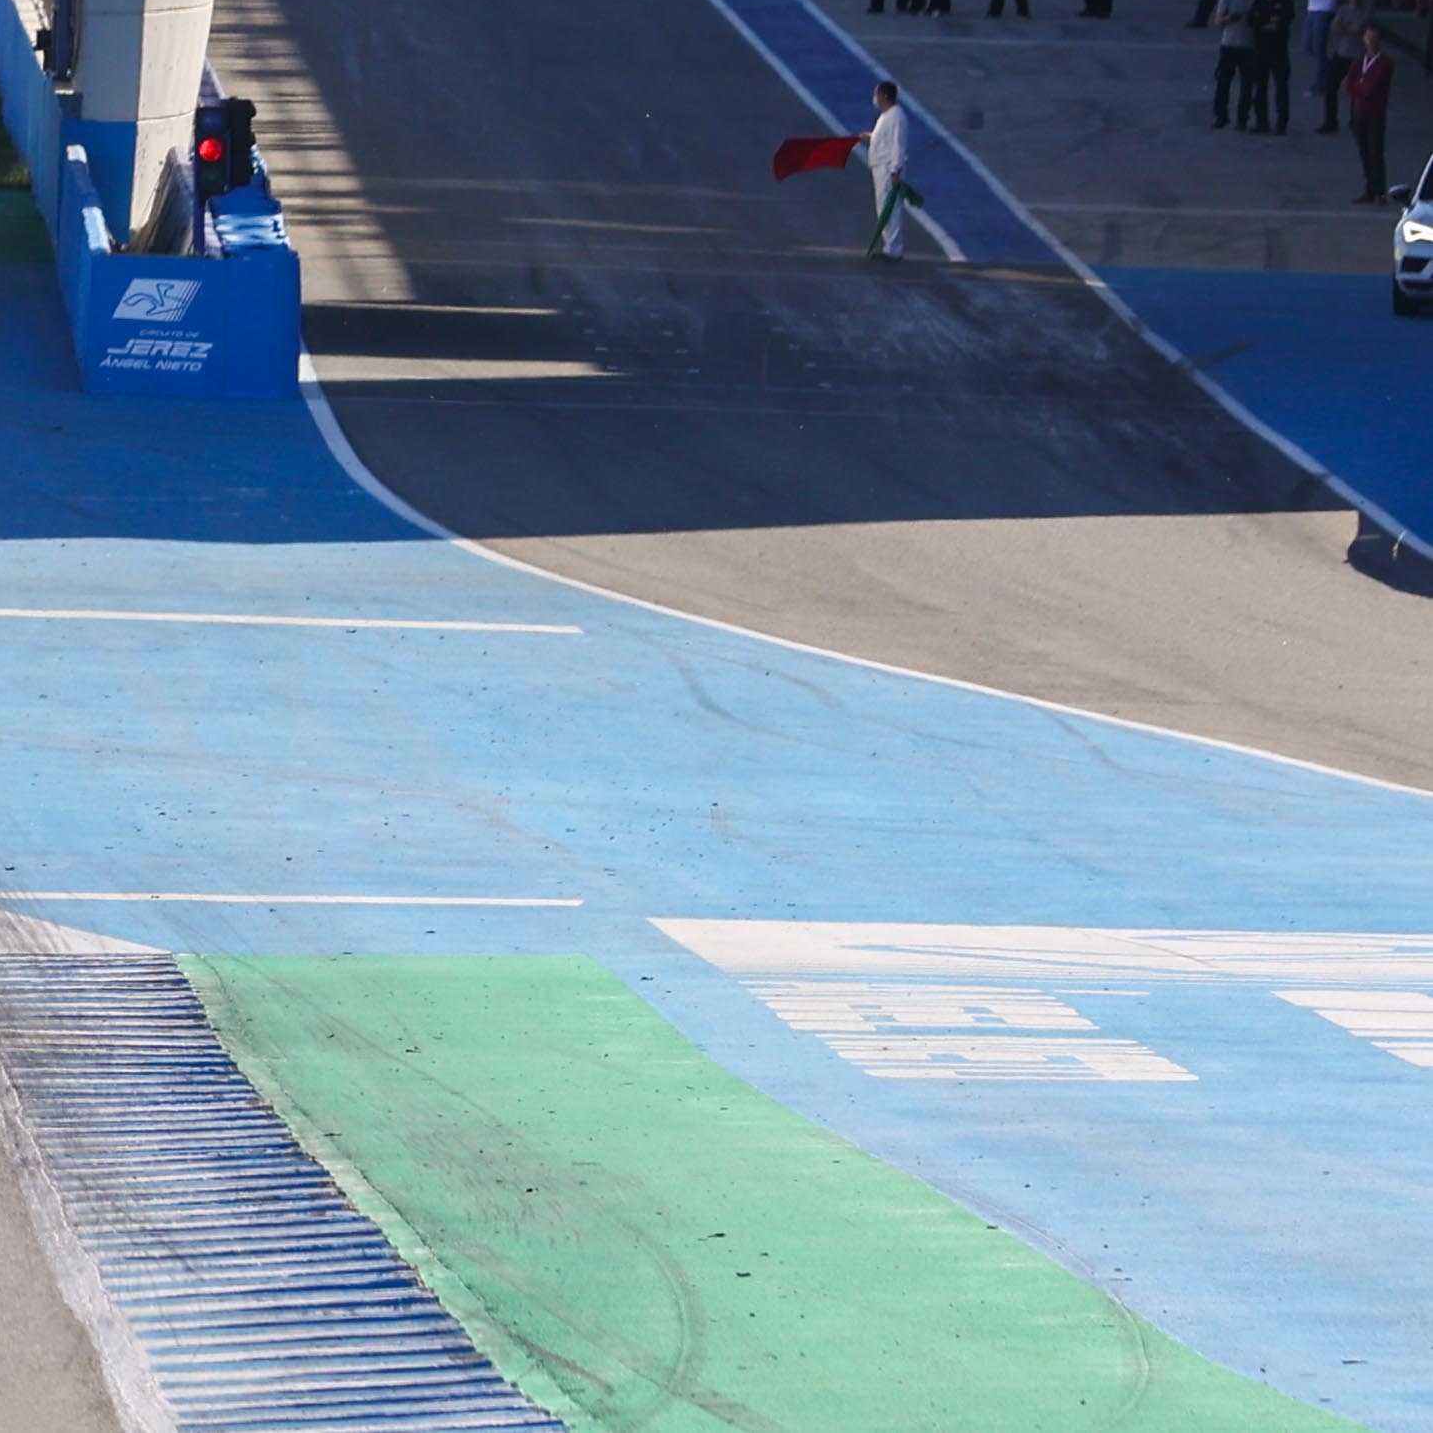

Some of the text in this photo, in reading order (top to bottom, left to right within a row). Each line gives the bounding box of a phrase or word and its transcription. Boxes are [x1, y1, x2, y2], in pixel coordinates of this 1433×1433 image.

[106, 338, 213, 359] JEREZ
[99, 354, 203, 372] ÁNGEL NIETO
